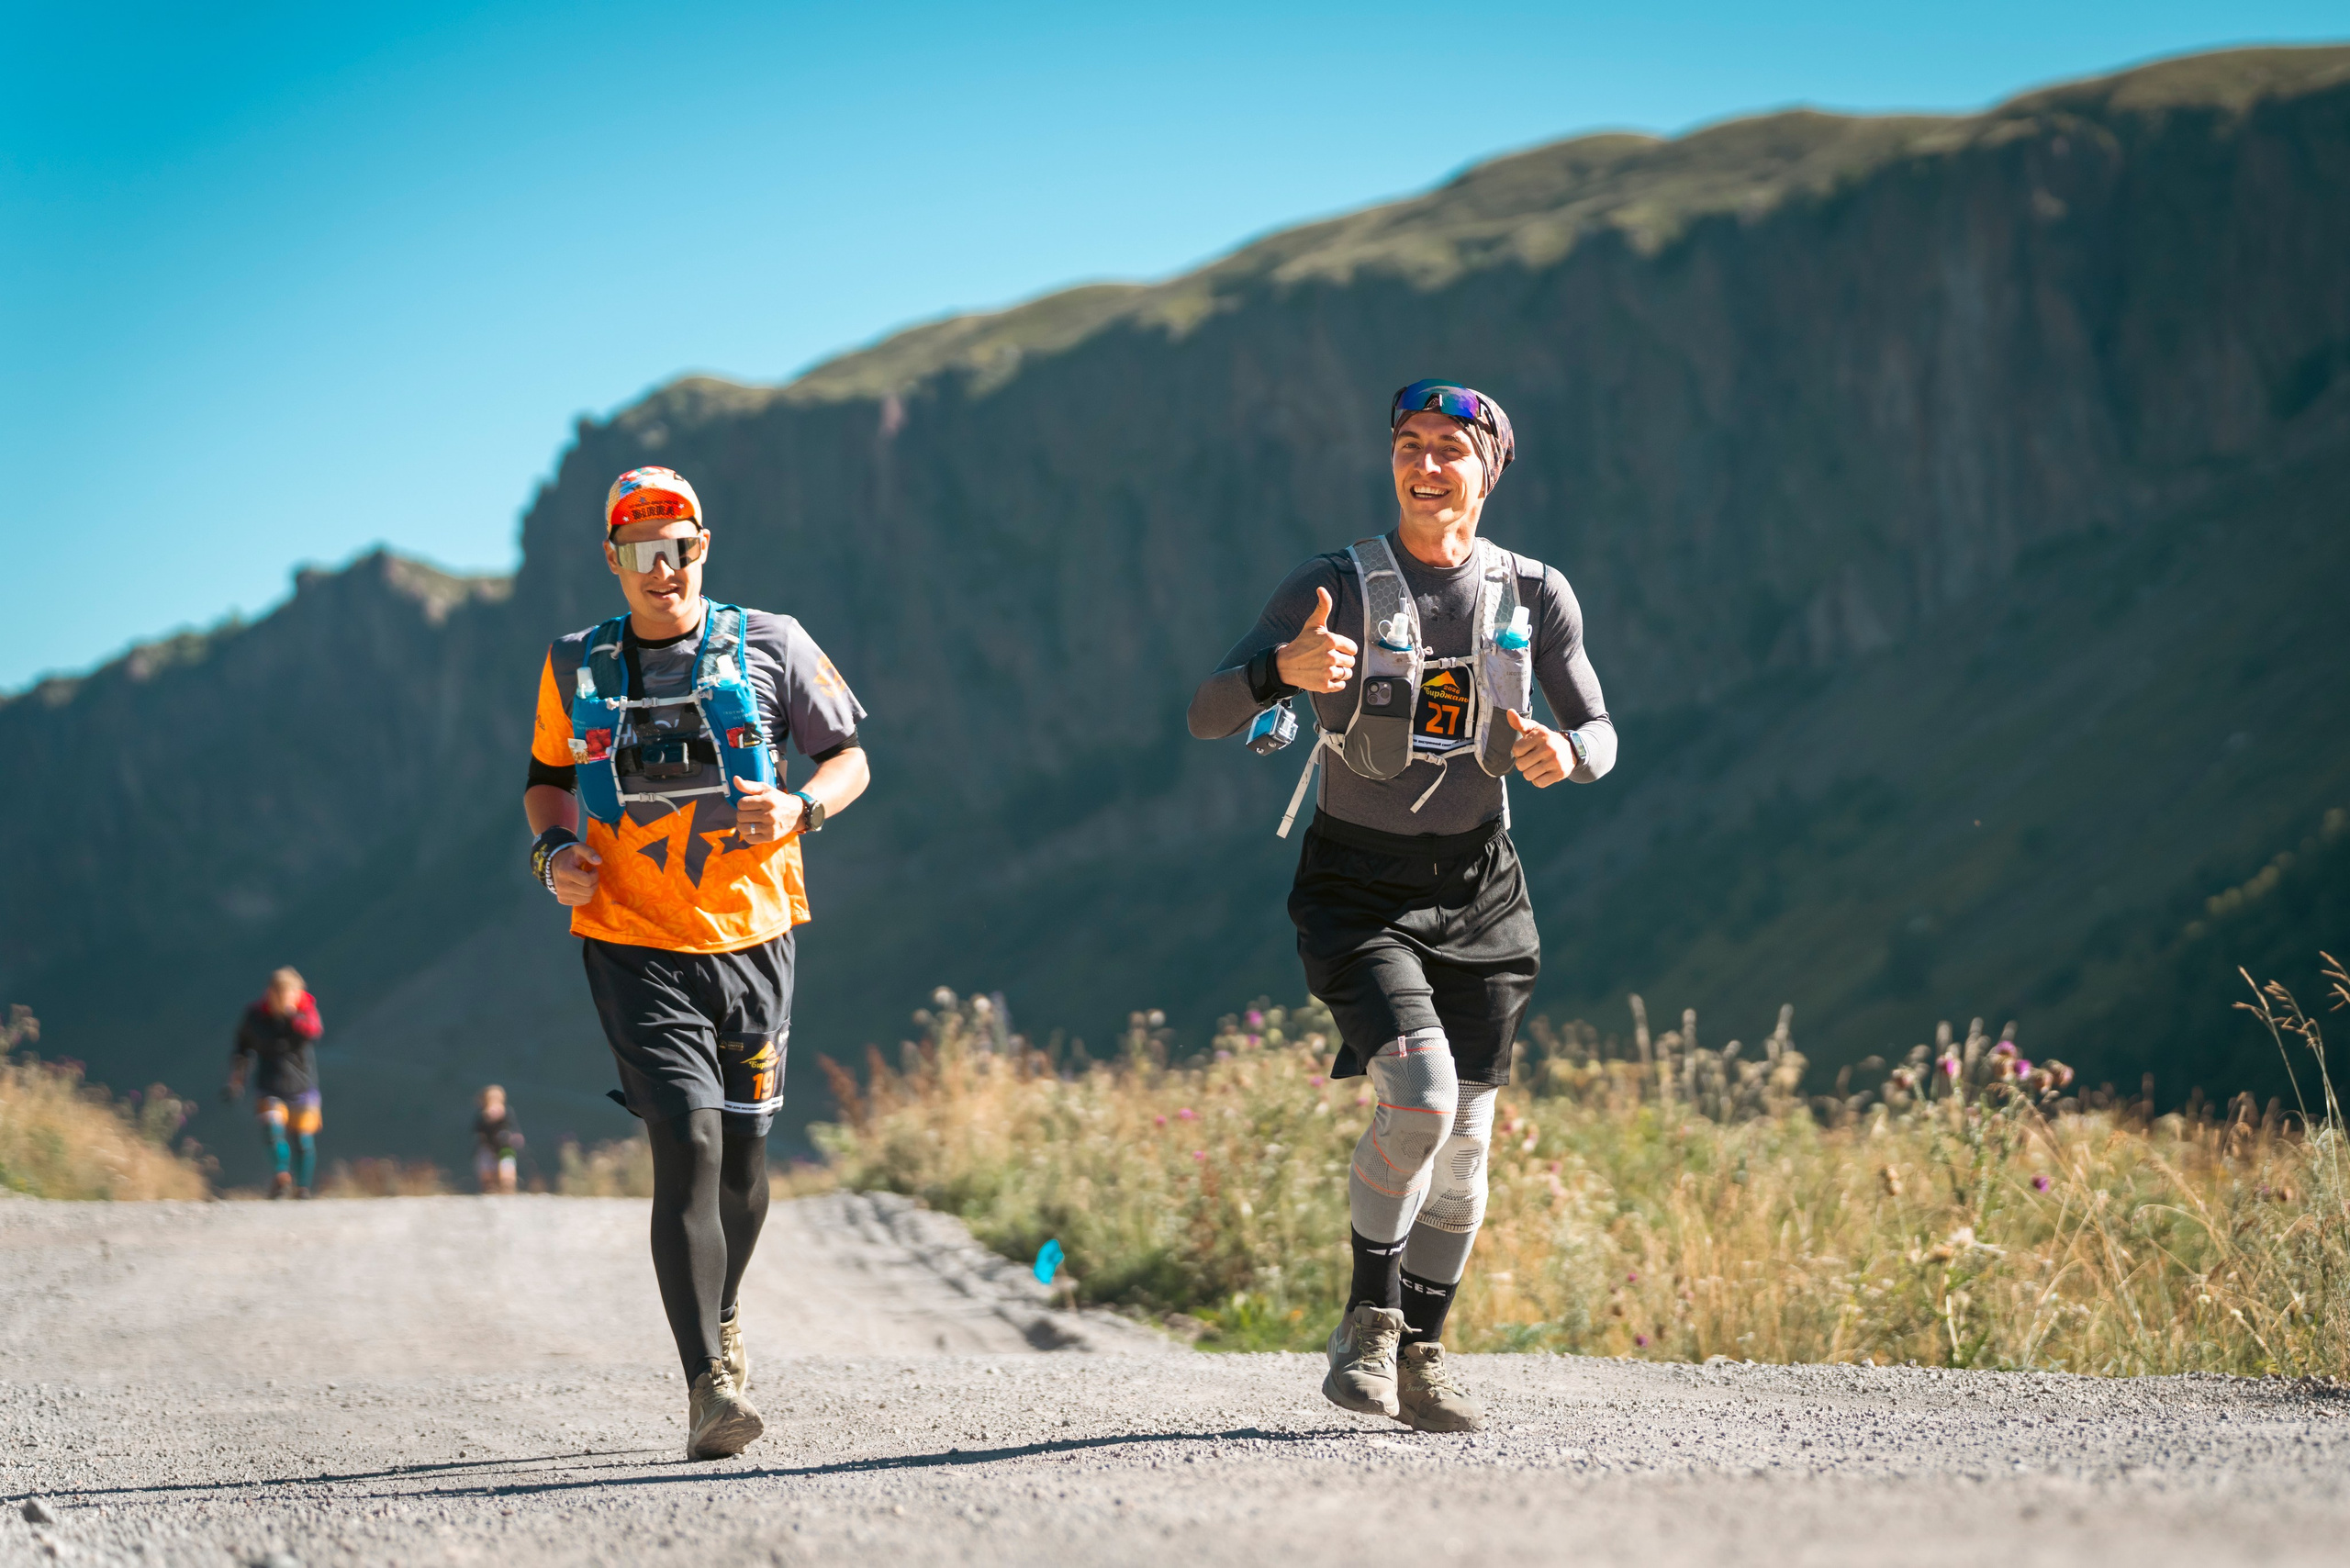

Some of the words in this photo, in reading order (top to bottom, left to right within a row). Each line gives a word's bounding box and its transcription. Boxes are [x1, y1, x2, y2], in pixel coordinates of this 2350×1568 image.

[1443, 685, 1460, 695] 2026
[1426, 701, 1460, 734] 27
[753, 1070, 775, 1100] 19
